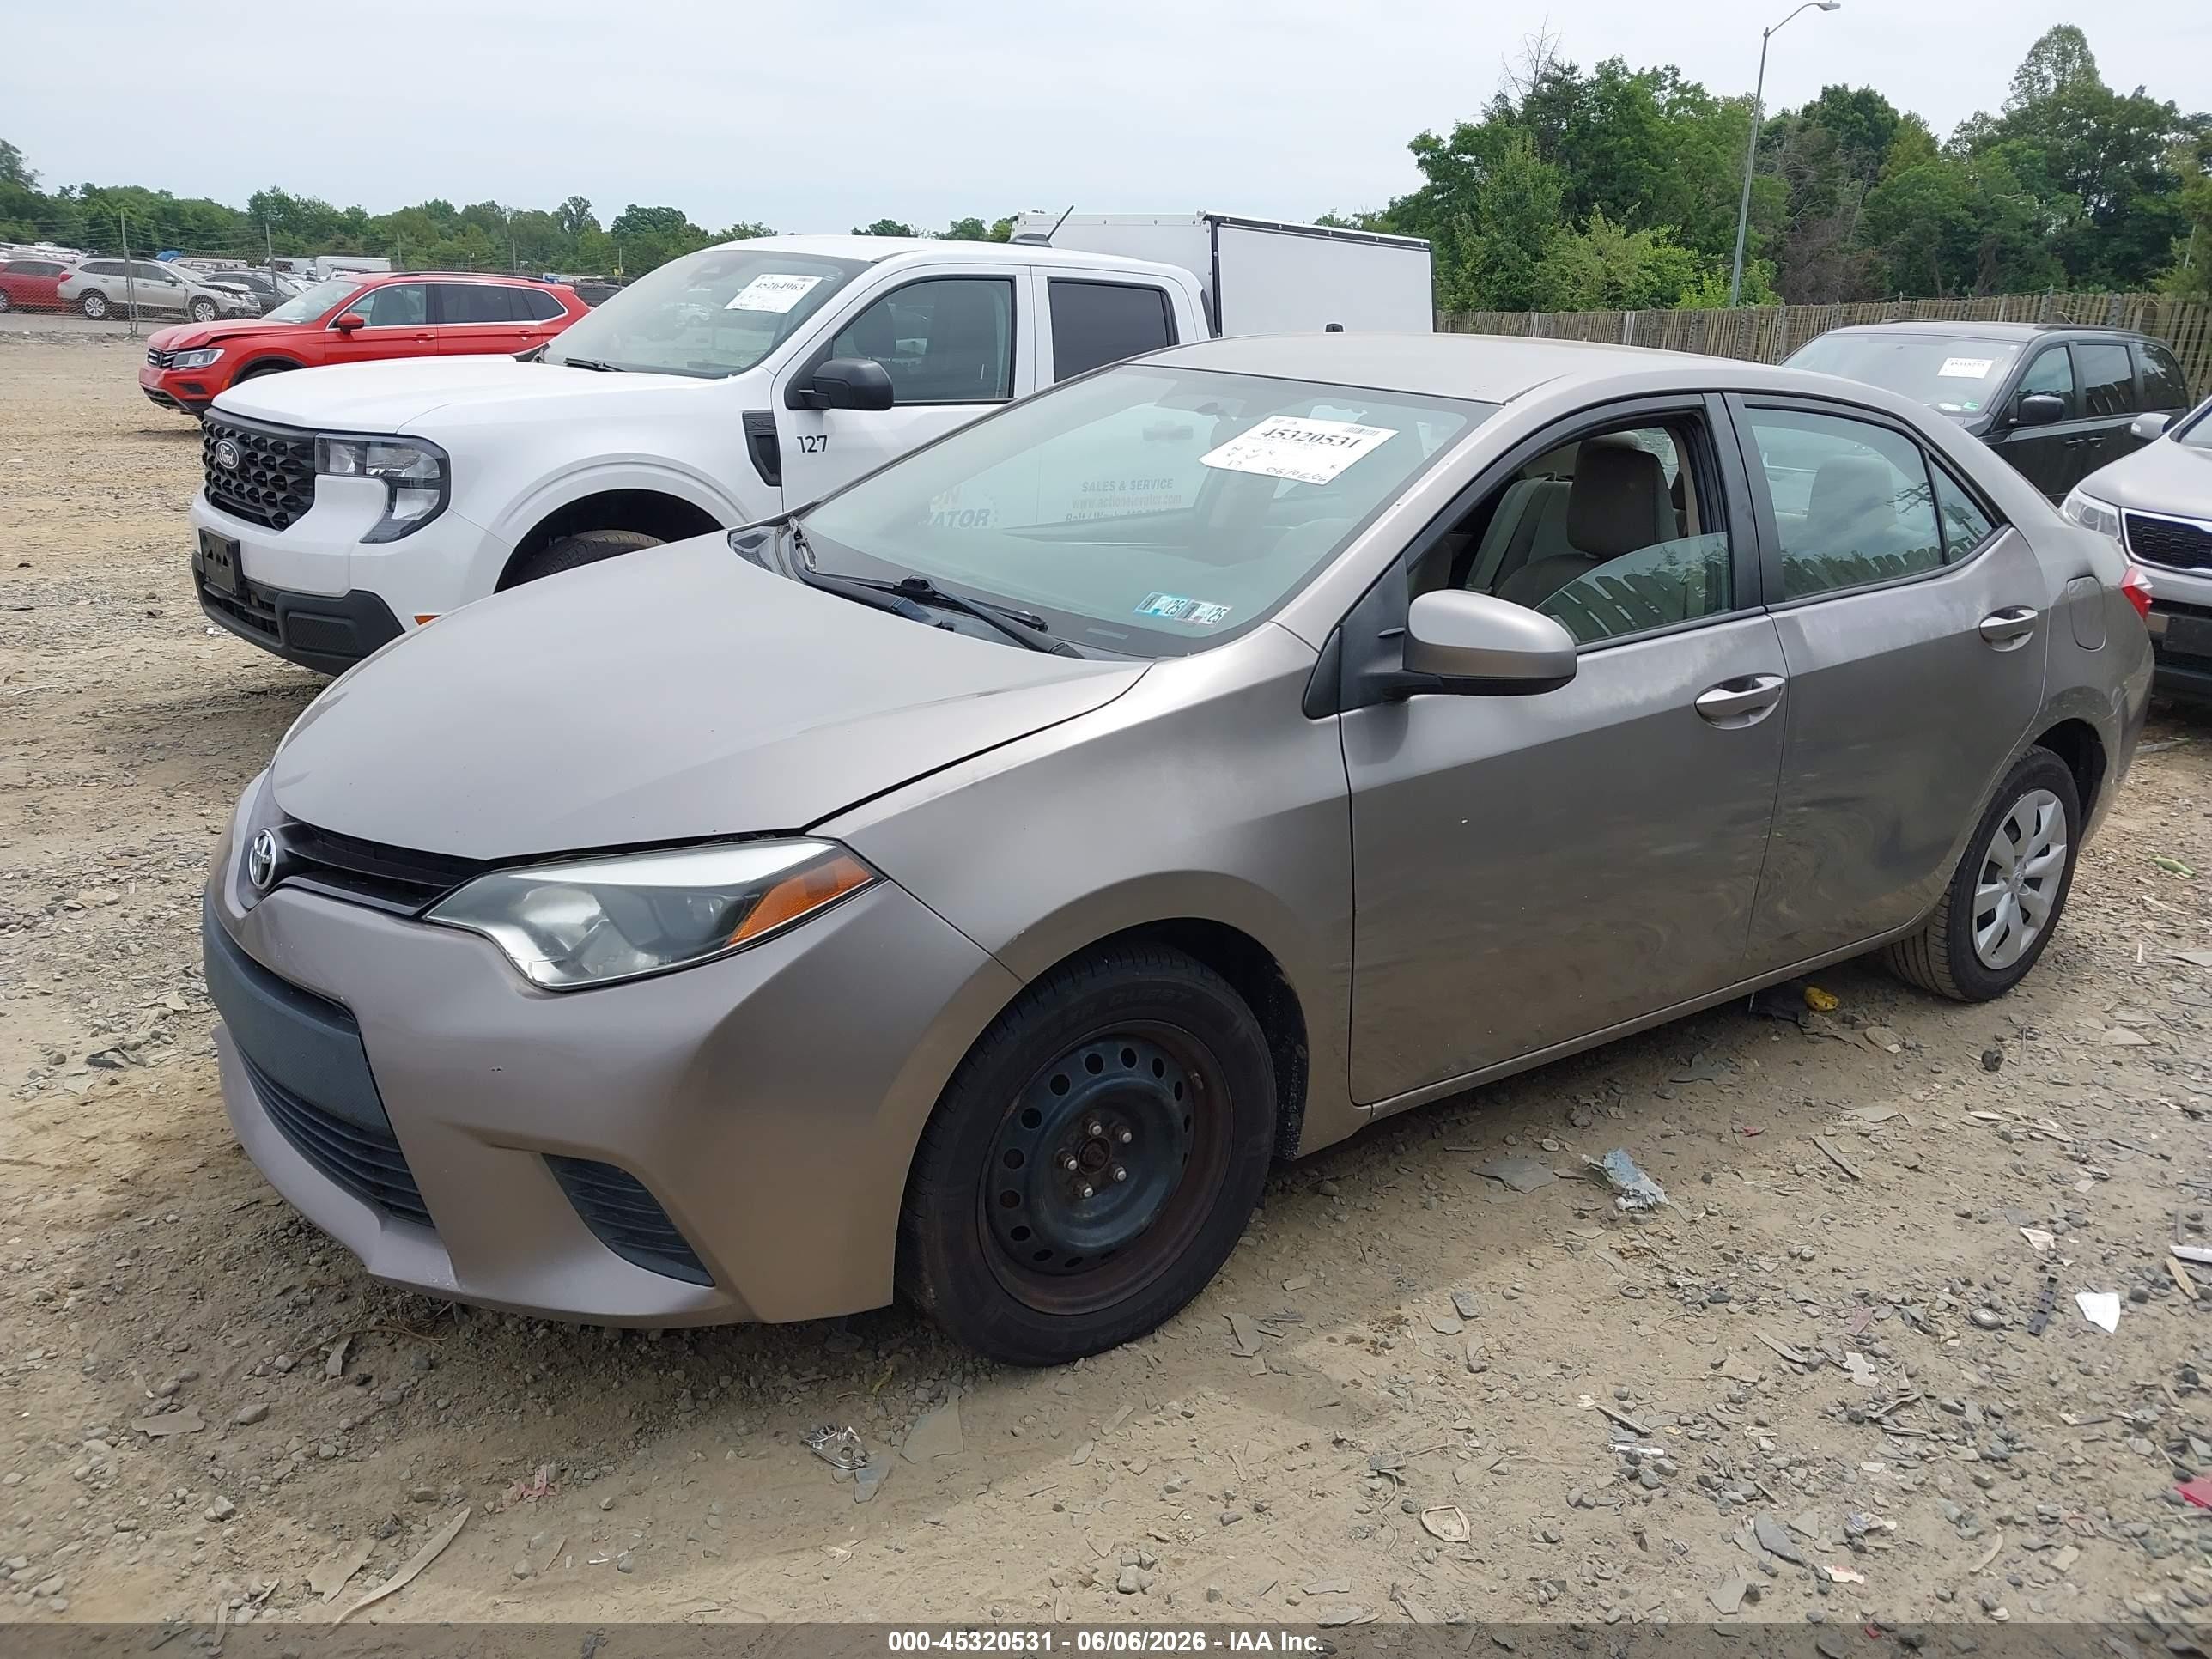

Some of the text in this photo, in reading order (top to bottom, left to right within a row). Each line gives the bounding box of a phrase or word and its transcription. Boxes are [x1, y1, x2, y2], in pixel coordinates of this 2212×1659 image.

[796, 434, 828, 453] 127
[1261, 428, 1363, 449] 45320531
[219, 444, 234, 465] Ford
[1082, 477, 1174, 493] SALES & SERVICE
